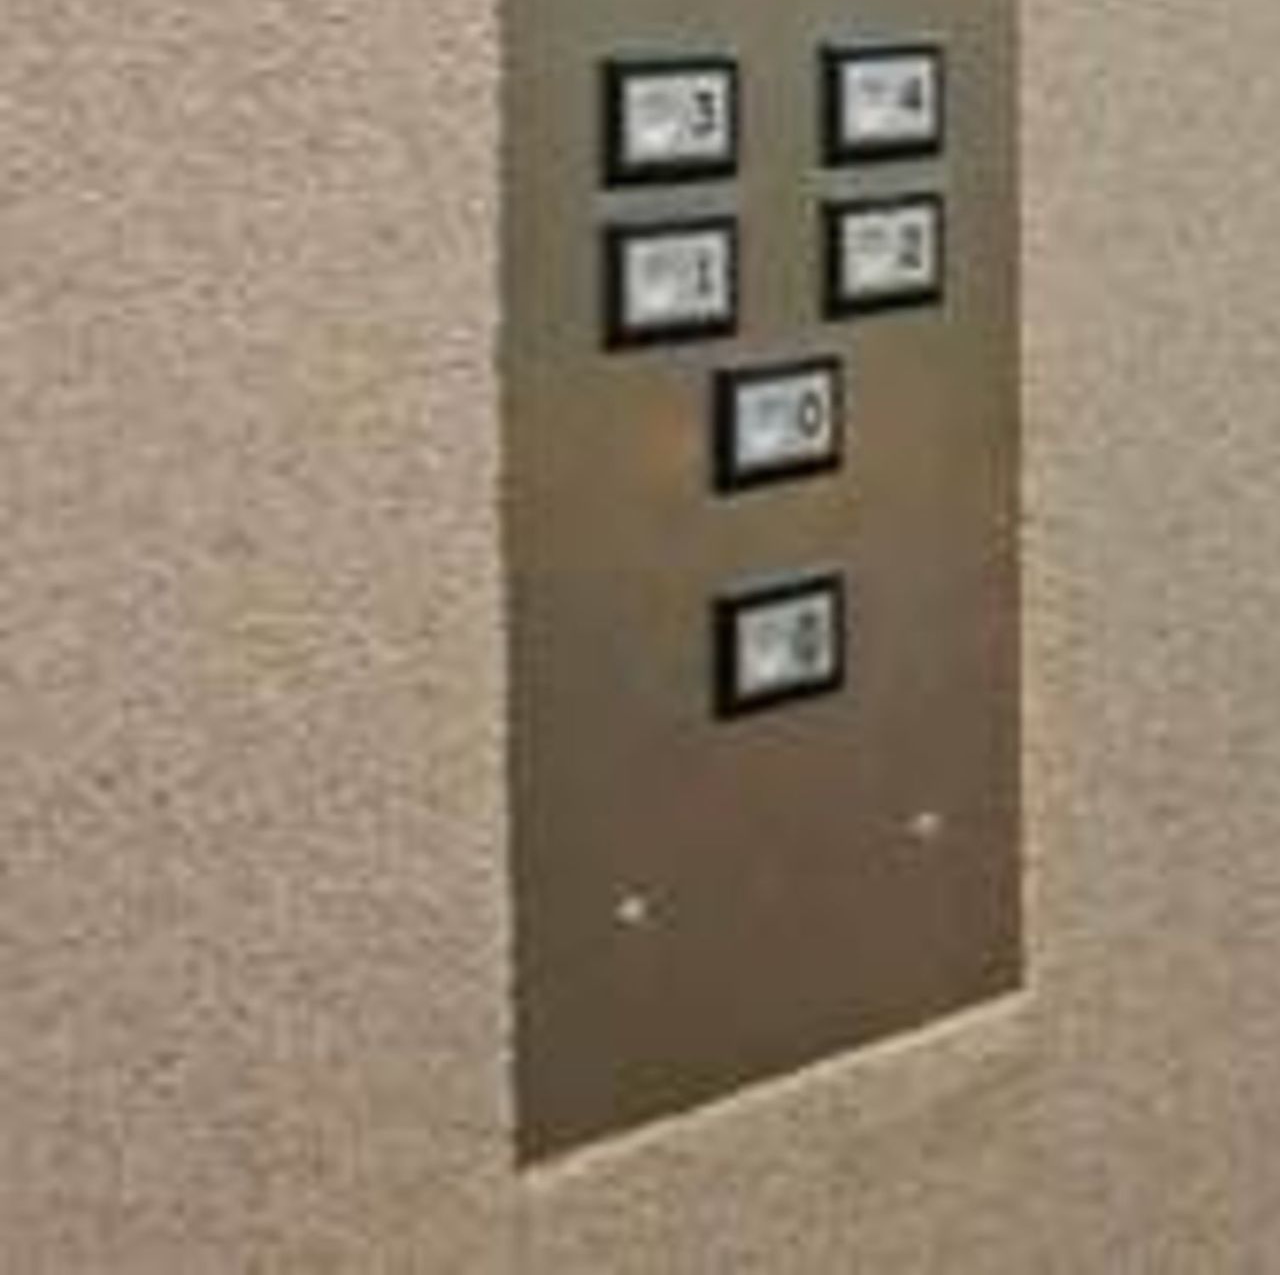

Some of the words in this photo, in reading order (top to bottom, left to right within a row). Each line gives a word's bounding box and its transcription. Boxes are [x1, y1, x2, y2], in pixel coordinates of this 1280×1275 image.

[691, 89, 717, 137] 3
[898, 76, 924, 113] 4
[898, 223, 924, 270] 2
